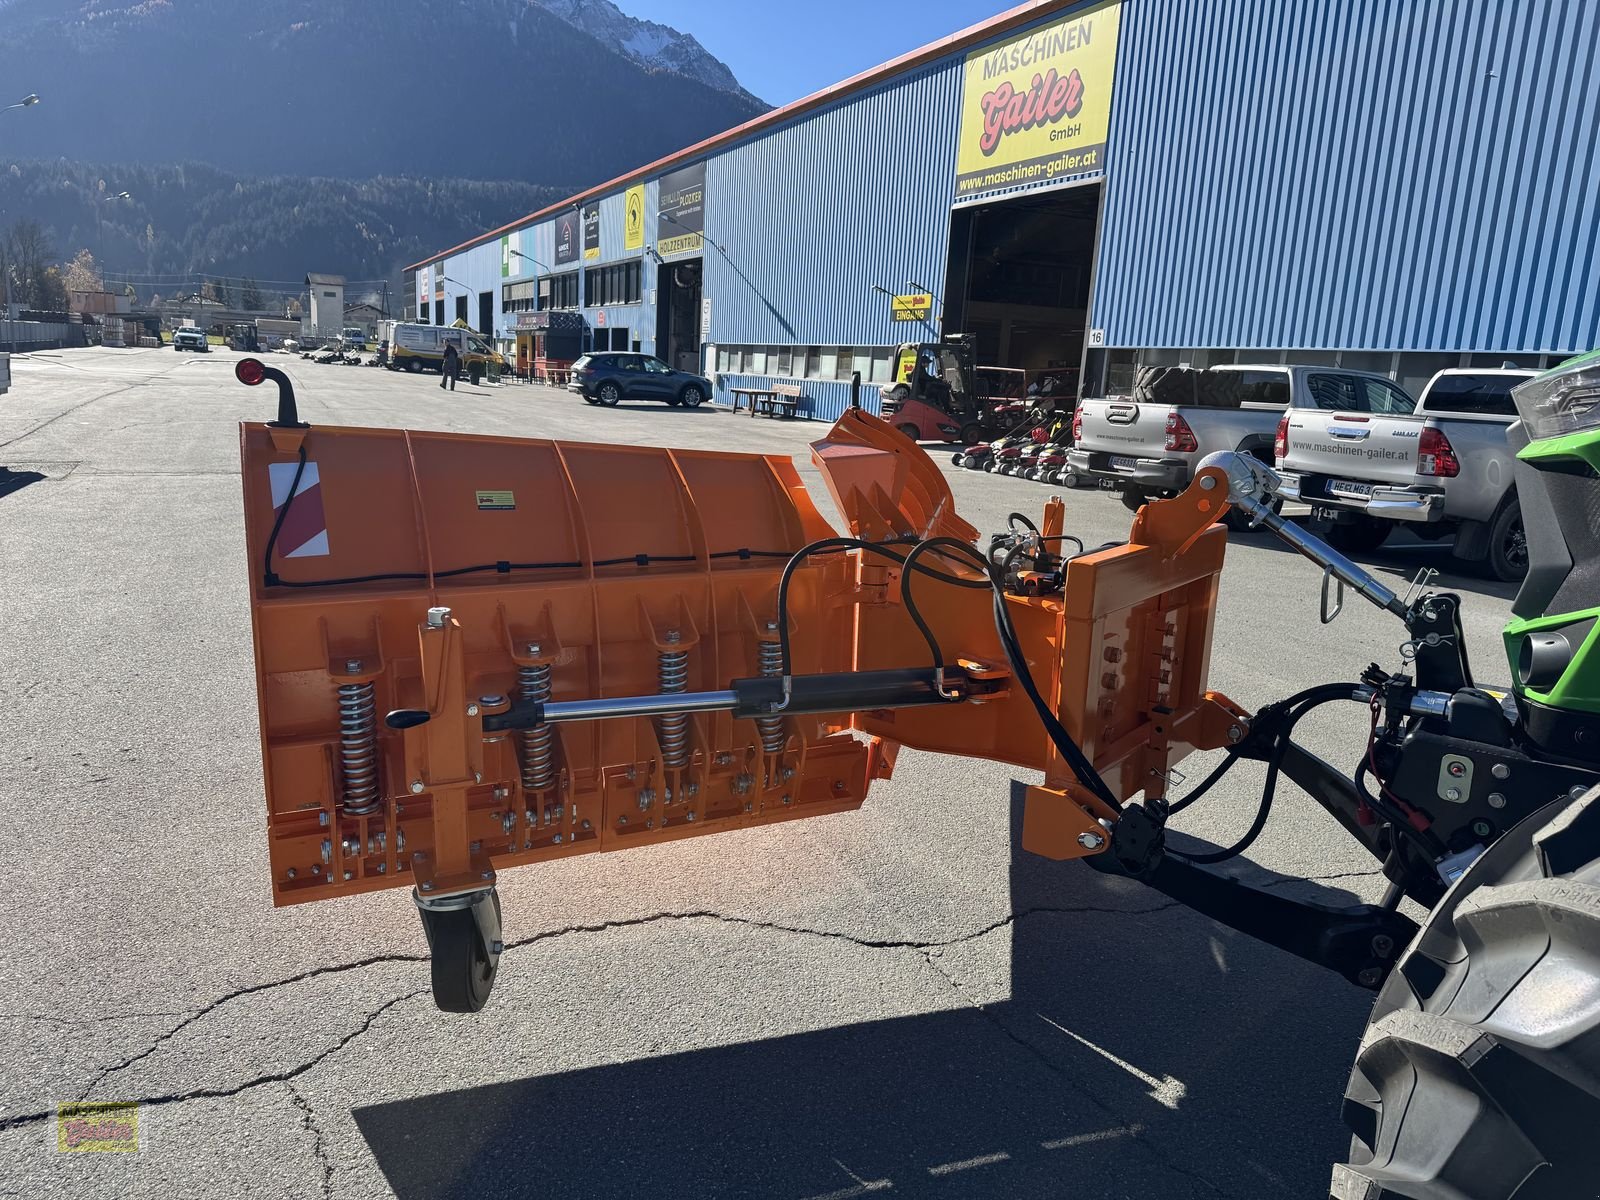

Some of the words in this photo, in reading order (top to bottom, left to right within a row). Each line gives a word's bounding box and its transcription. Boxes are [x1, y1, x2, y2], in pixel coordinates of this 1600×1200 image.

[983, 21, 1092, 80] MASCHINEN
[980, 68, 1084, 157] Gailer
[1050, 123, 1081, 141] GmbH
[959, 150, 1096, 191] www.maschinen-gailer.at
[660, 235, 701, 253] HOLZZENTRUM
[896, 309, 925, 320] EINGANG
[1092, 332, 1101, 343] 16
[1292, 441, 1409, 461] www.maschinen-gailer.at
[1334, 482, 1345, 491] HE
